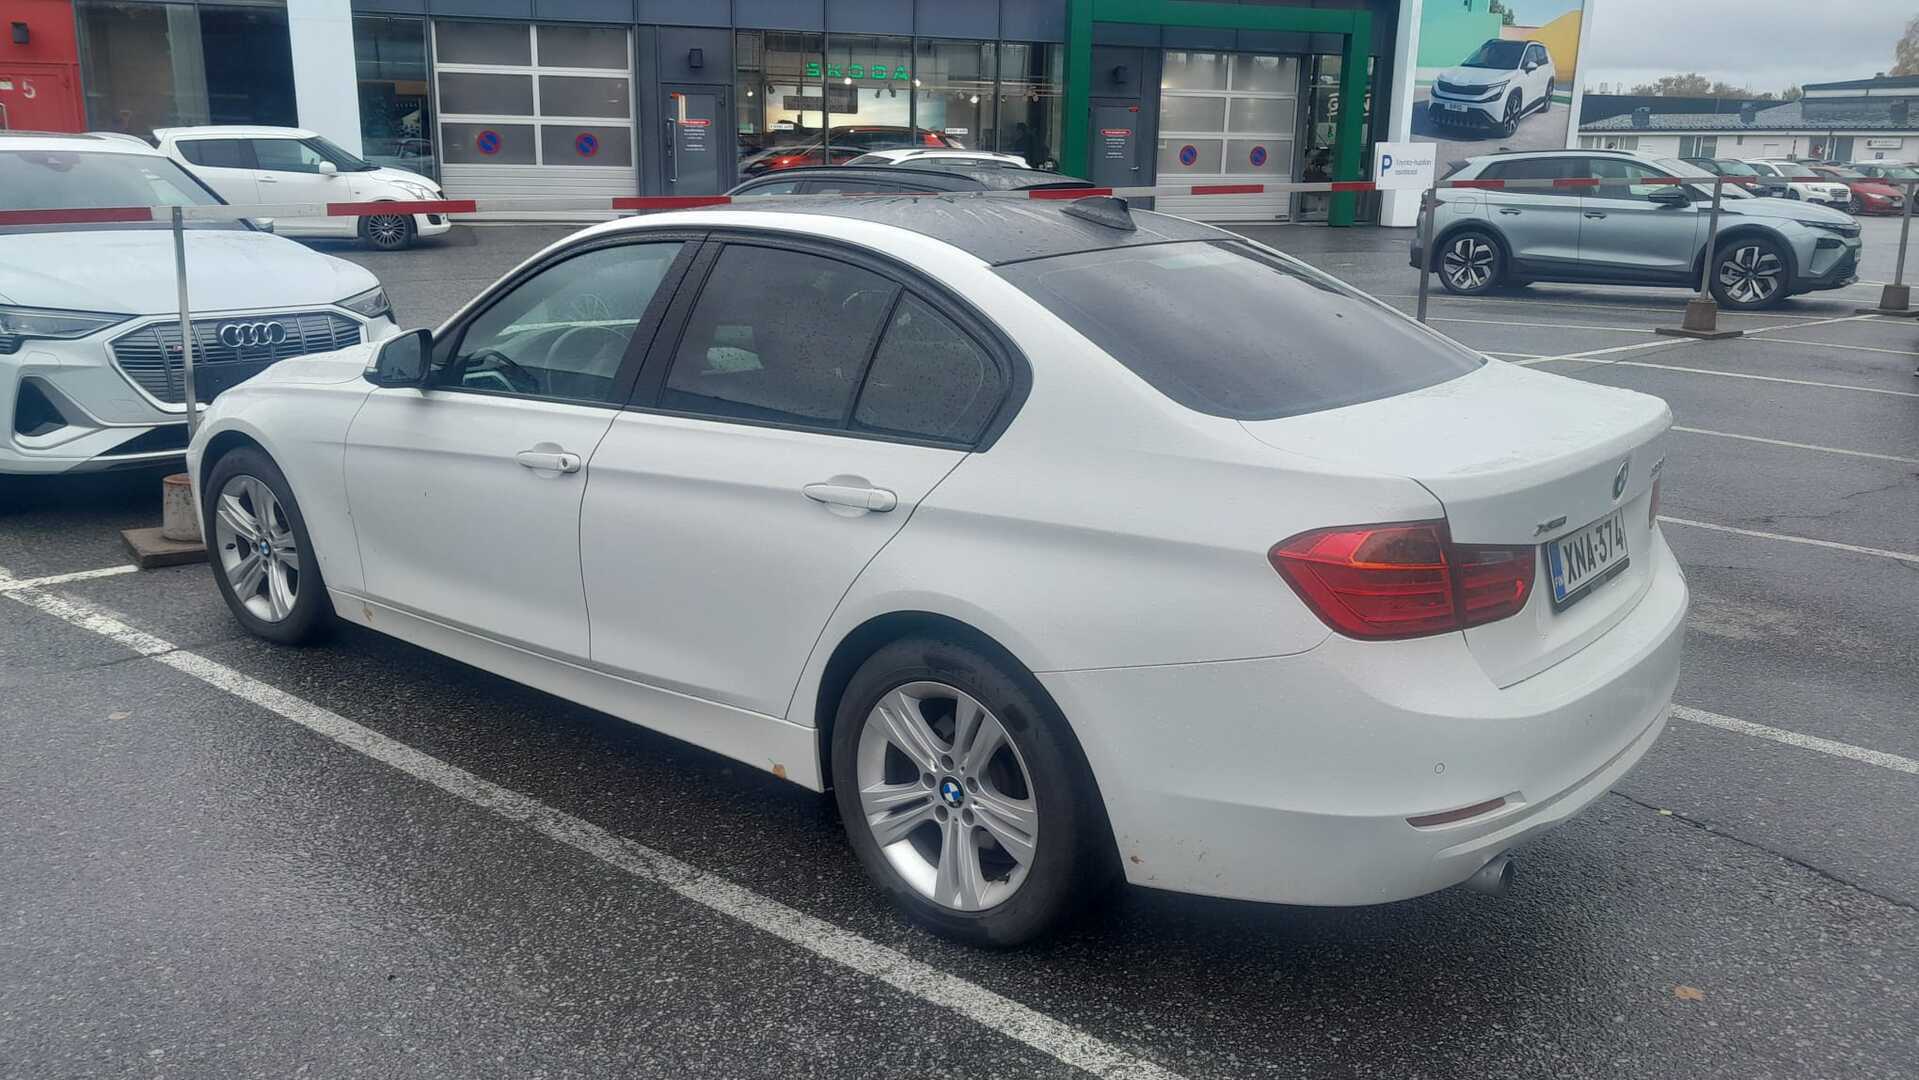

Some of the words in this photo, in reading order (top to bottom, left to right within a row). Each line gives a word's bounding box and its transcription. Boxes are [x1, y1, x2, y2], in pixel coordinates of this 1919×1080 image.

[22, 80, 36, 98] 5
[1381, 154, 1393, 177] P
[1563, 515, 1624, 584] XNA-374
